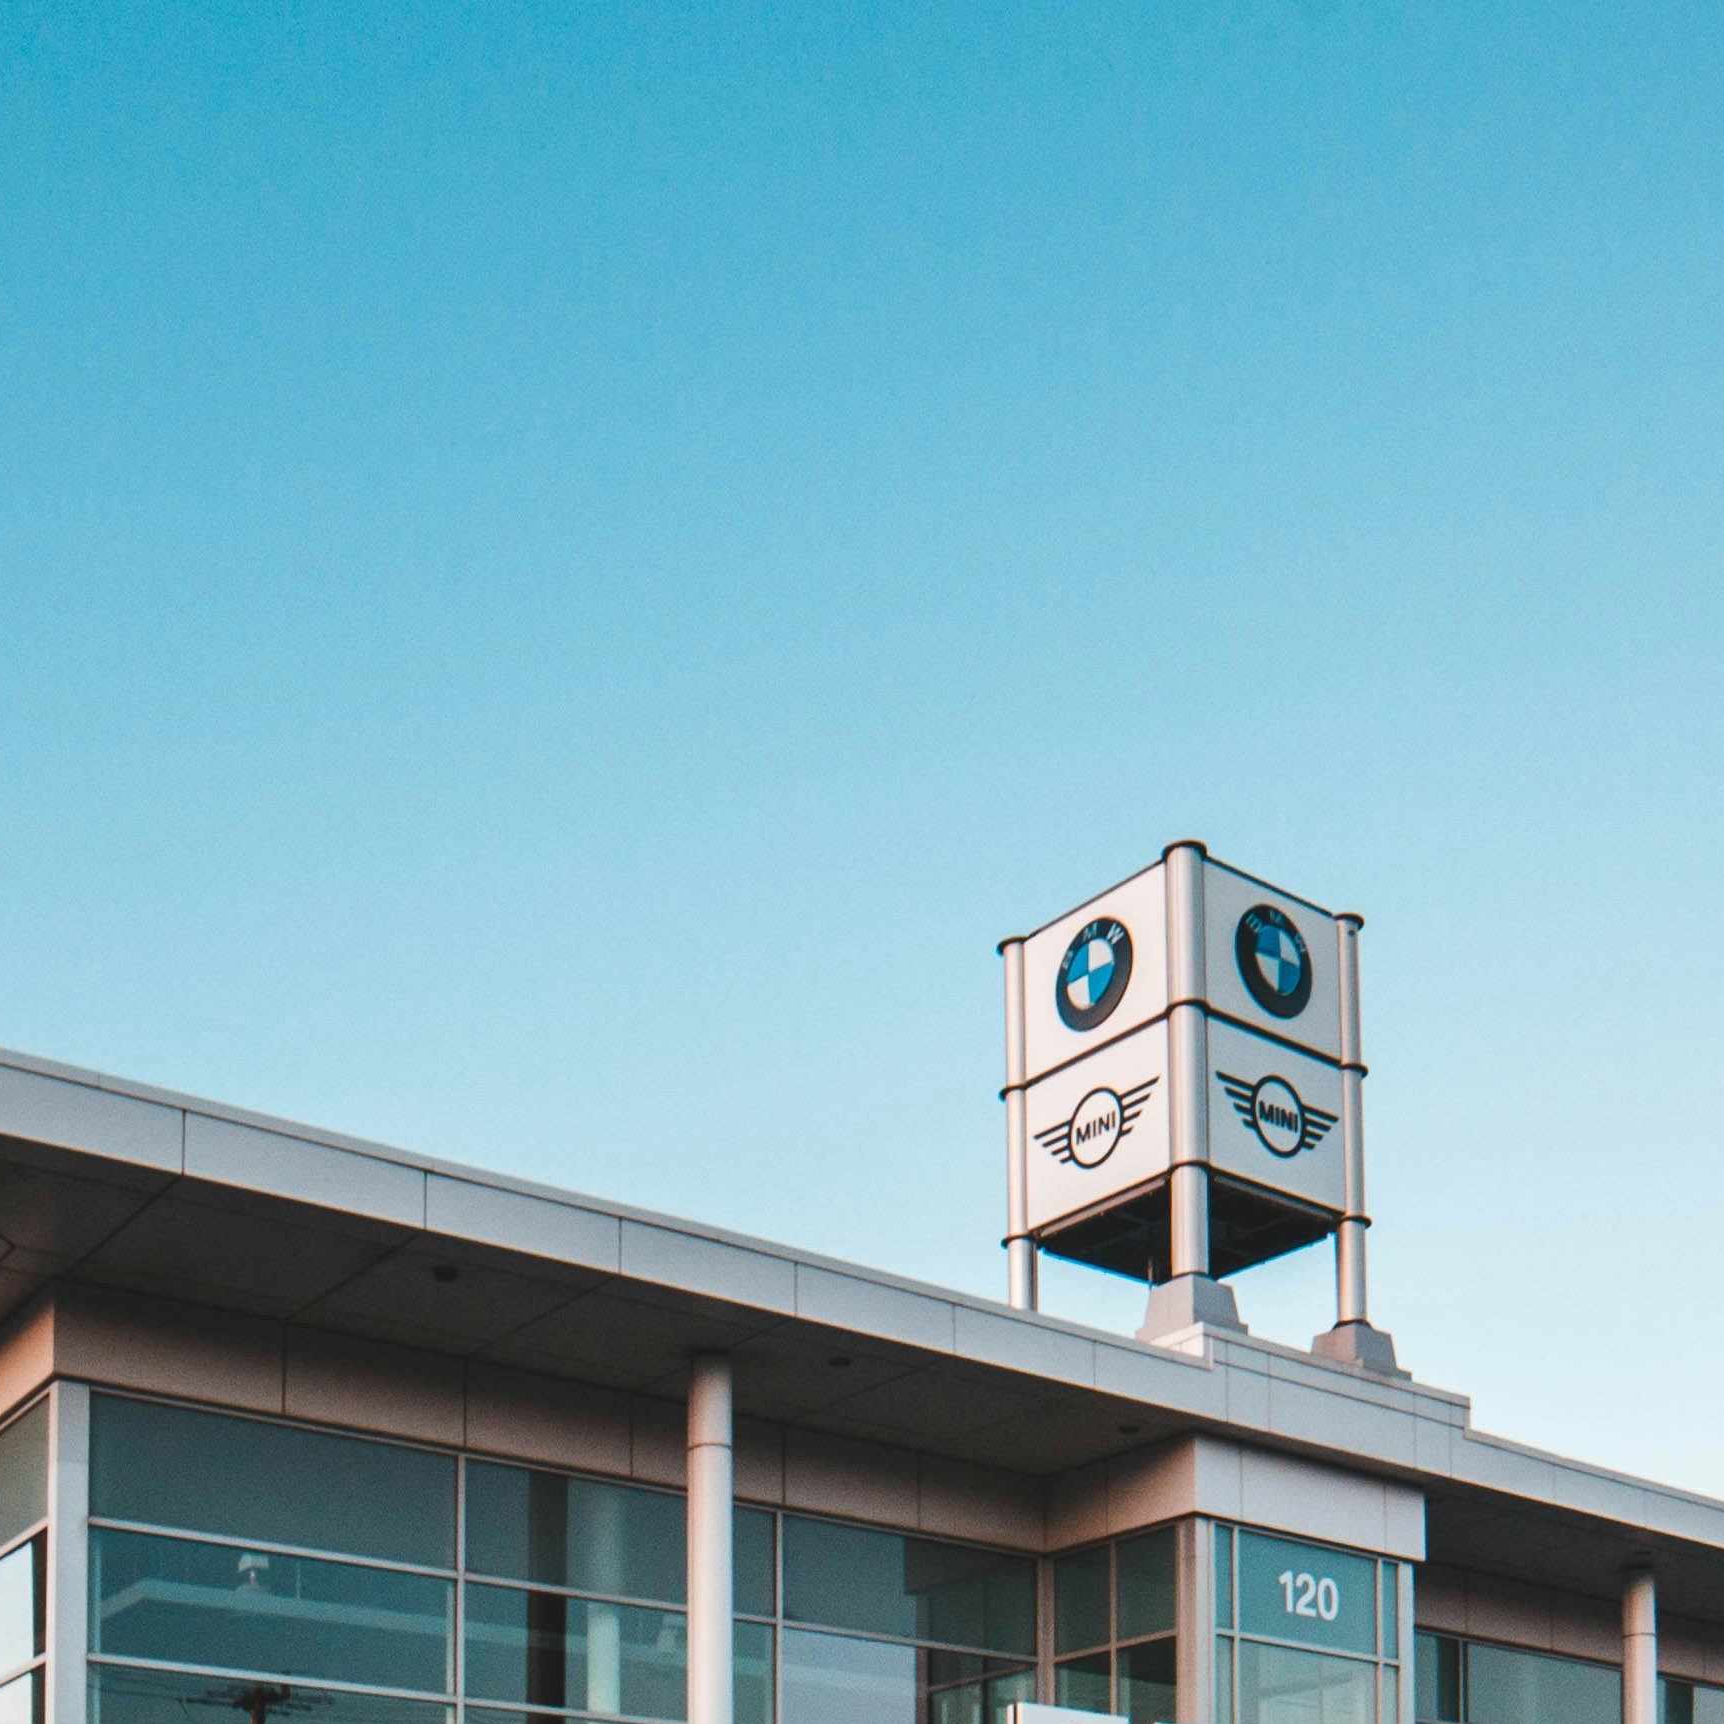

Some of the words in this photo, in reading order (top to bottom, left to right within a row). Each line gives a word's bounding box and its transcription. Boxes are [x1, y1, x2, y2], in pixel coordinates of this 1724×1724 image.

[1063, 921, 1125, 970] BMW
[1245, 909, 1306, 953] BMW
[1076, 1109, 1117, 1145] MINI
[1258, 1100, 1300, 1133] MINI
[1278, 1570, 1339, 1620] 120
